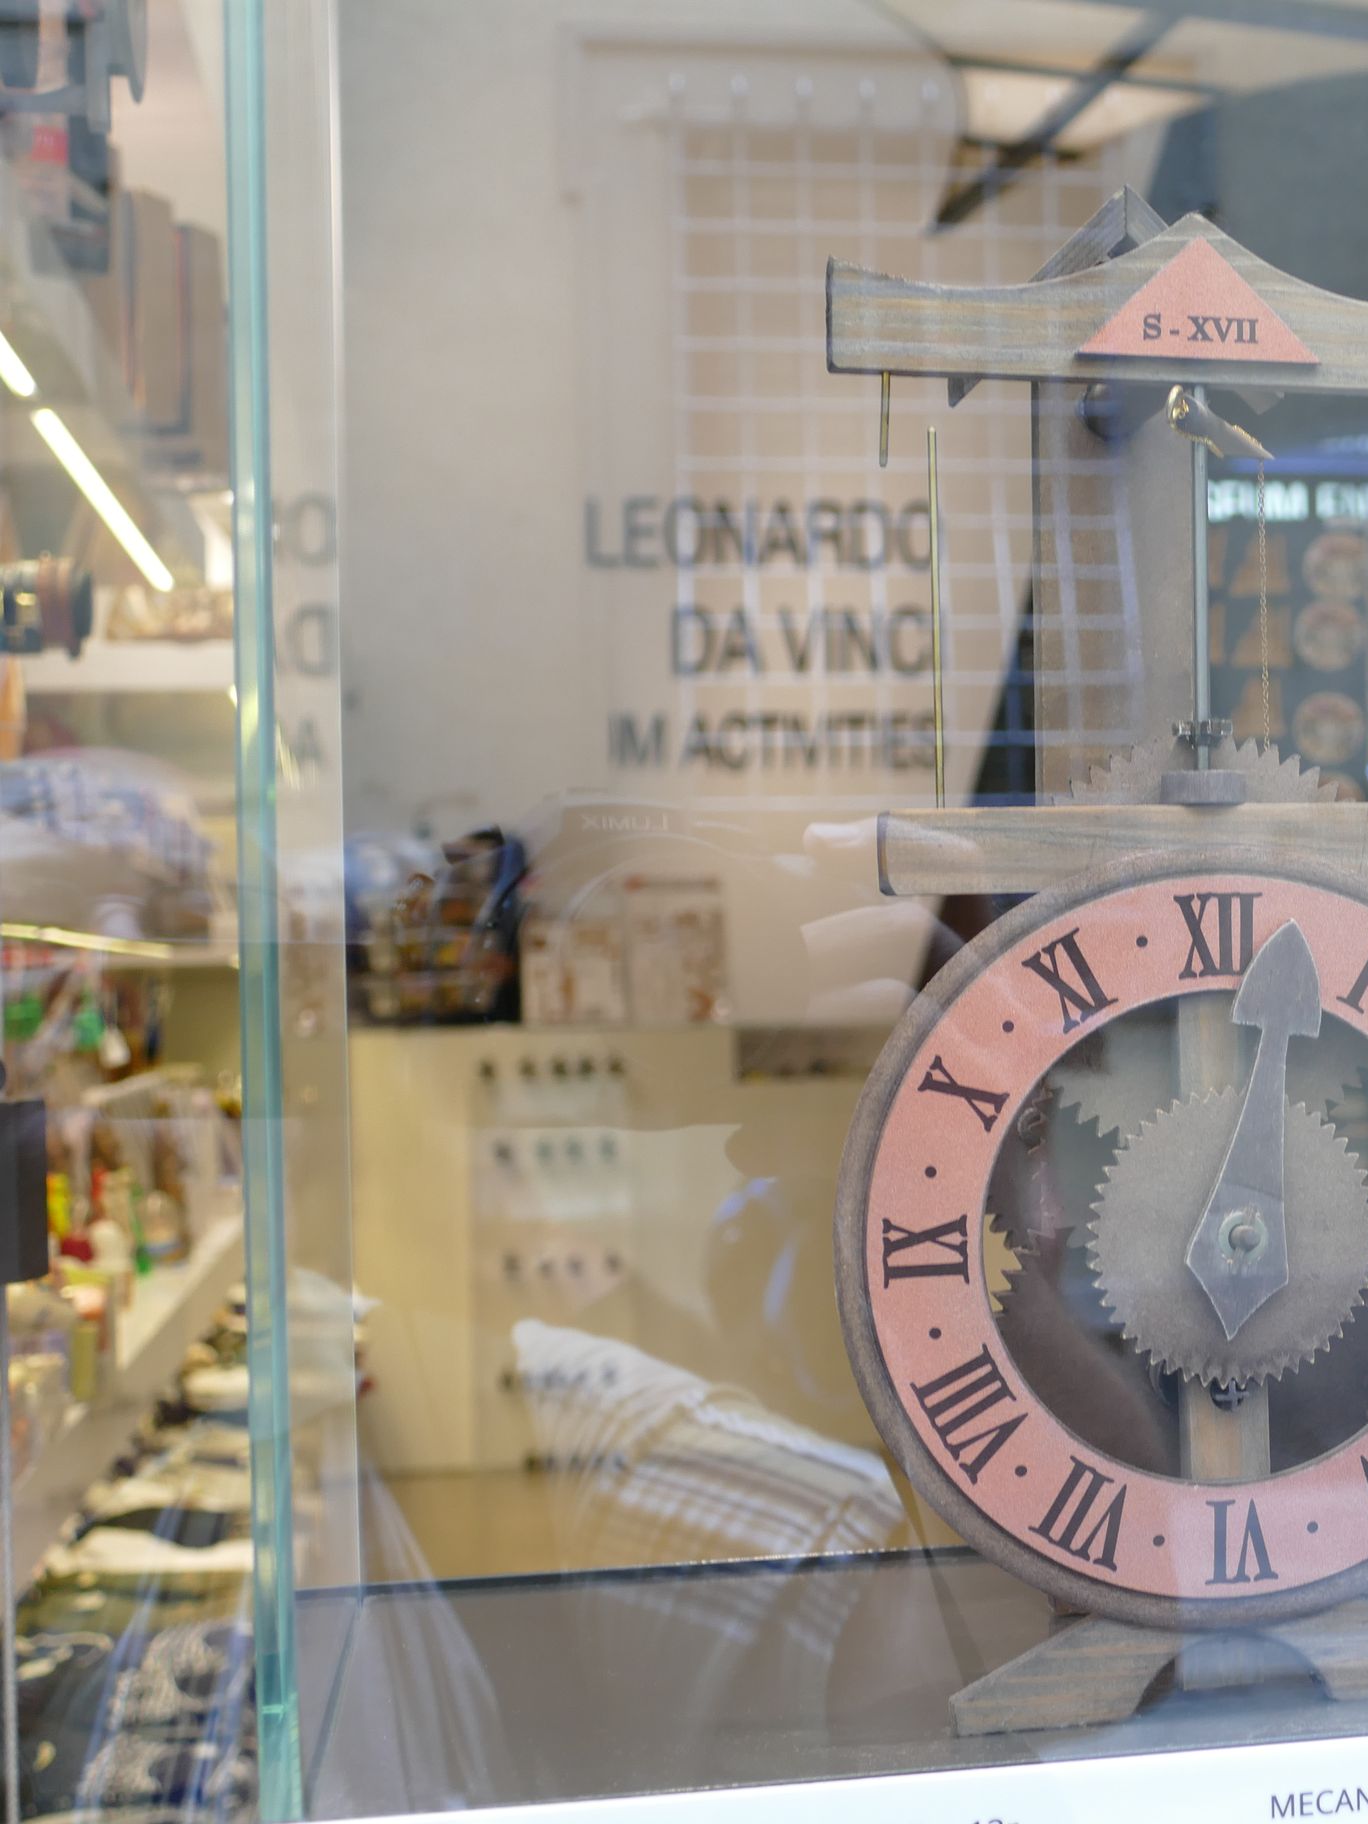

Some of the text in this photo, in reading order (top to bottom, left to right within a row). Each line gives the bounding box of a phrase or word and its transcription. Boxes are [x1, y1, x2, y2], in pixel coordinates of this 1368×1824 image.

[1143, 312, 1162, 341] S
[1187, 315, 1259, 344] XVII
[584, 496, 944, 571] LEONARDO
[671, 604, 945, 677] DA VINC
[1173, 892, 1262, 980] XII
[1022, 928, 1119, 1034] XI
[918, 1055, 1010, 1132] X
[910, 1343, 1029, 1485] VIII
[1029, 1455, 1128, 1572] VII
